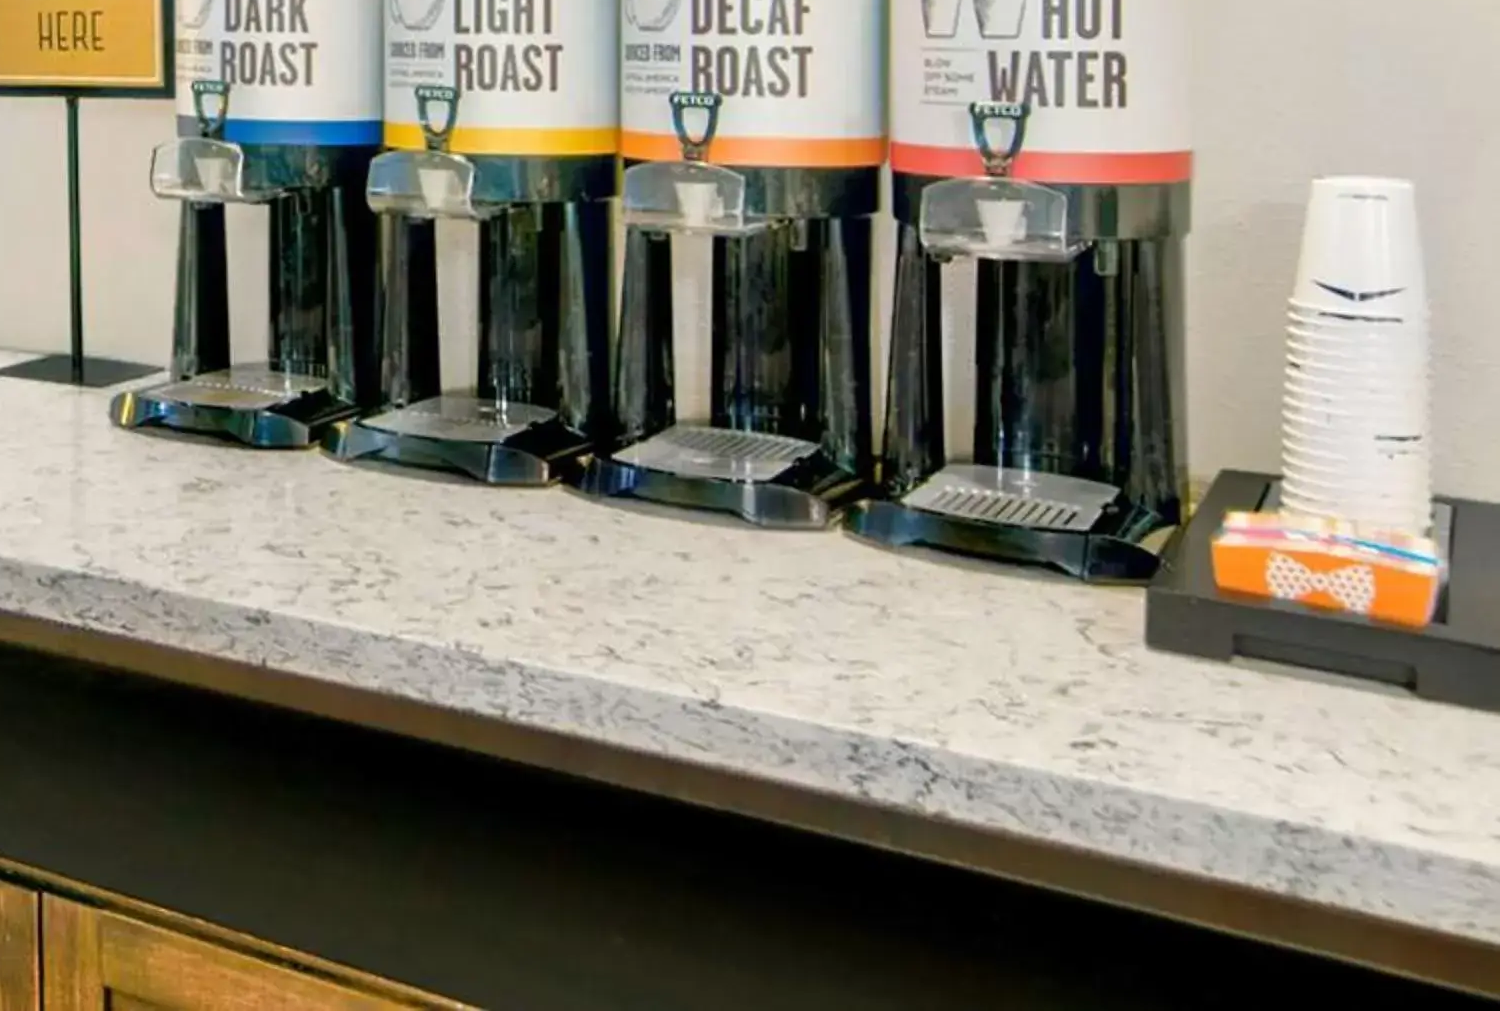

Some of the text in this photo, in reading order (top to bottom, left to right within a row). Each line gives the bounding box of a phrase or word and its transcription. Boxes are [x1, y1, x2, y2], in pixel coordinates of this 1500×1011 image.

[37, 10, 106, 52] HERE
[220, 40, 318, 86] ROAST
[454, 43, 563, 92] ROAST
[691, 45, 814, 98] ROAST
[987, 50, 1128, 108] WATER
